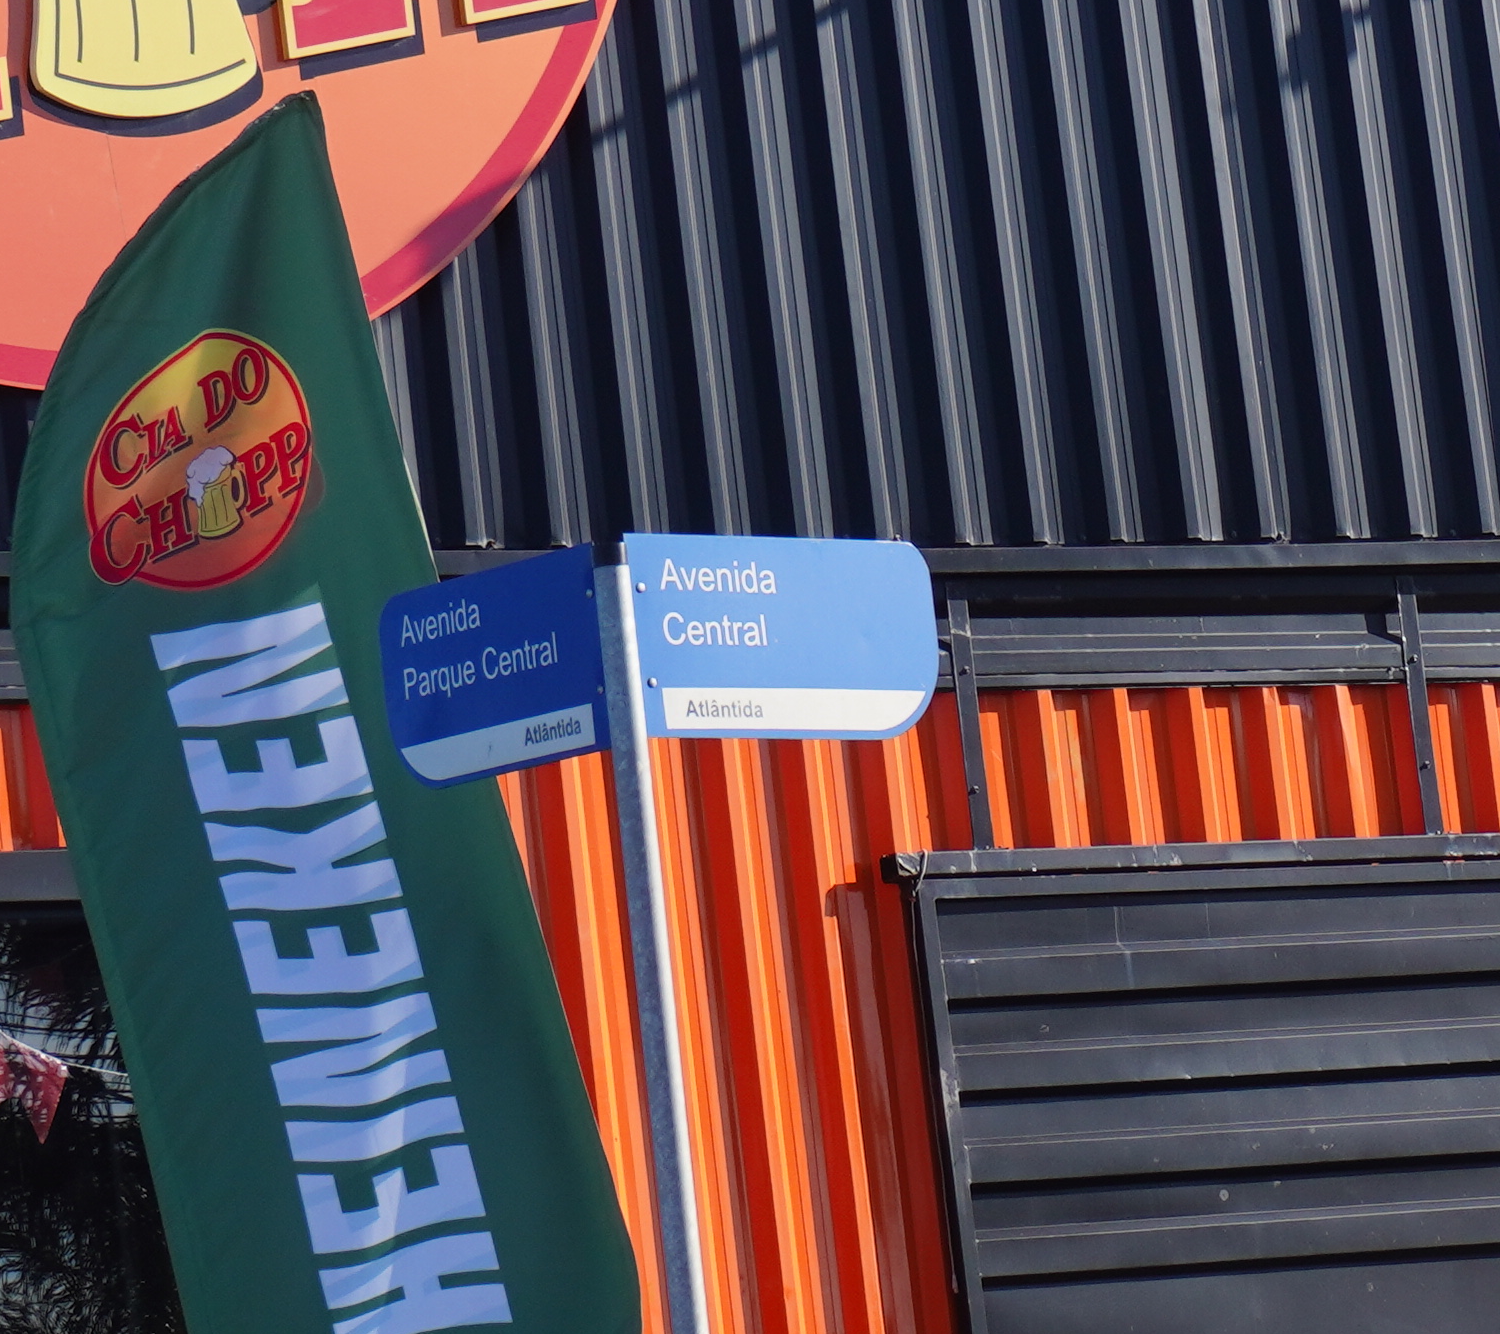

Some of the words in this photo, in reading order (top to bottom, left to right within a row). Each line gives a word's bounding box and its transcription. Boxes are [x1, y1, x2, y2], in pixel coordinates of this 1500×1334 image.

[196, 347, 270, 434] DO
[89, 421, 314, 587] CHPP
[659, 557, 777, 595] Avenida
[400, 599, 482, 648] Avenida
[662, 611, 769, 648] Central
[403, 654, 477, 701] Parque
[481, 631, 559, 682] Central
[685, 698, 765, 720] Atlântida
[523, 715, 583, 747] Atlântida
